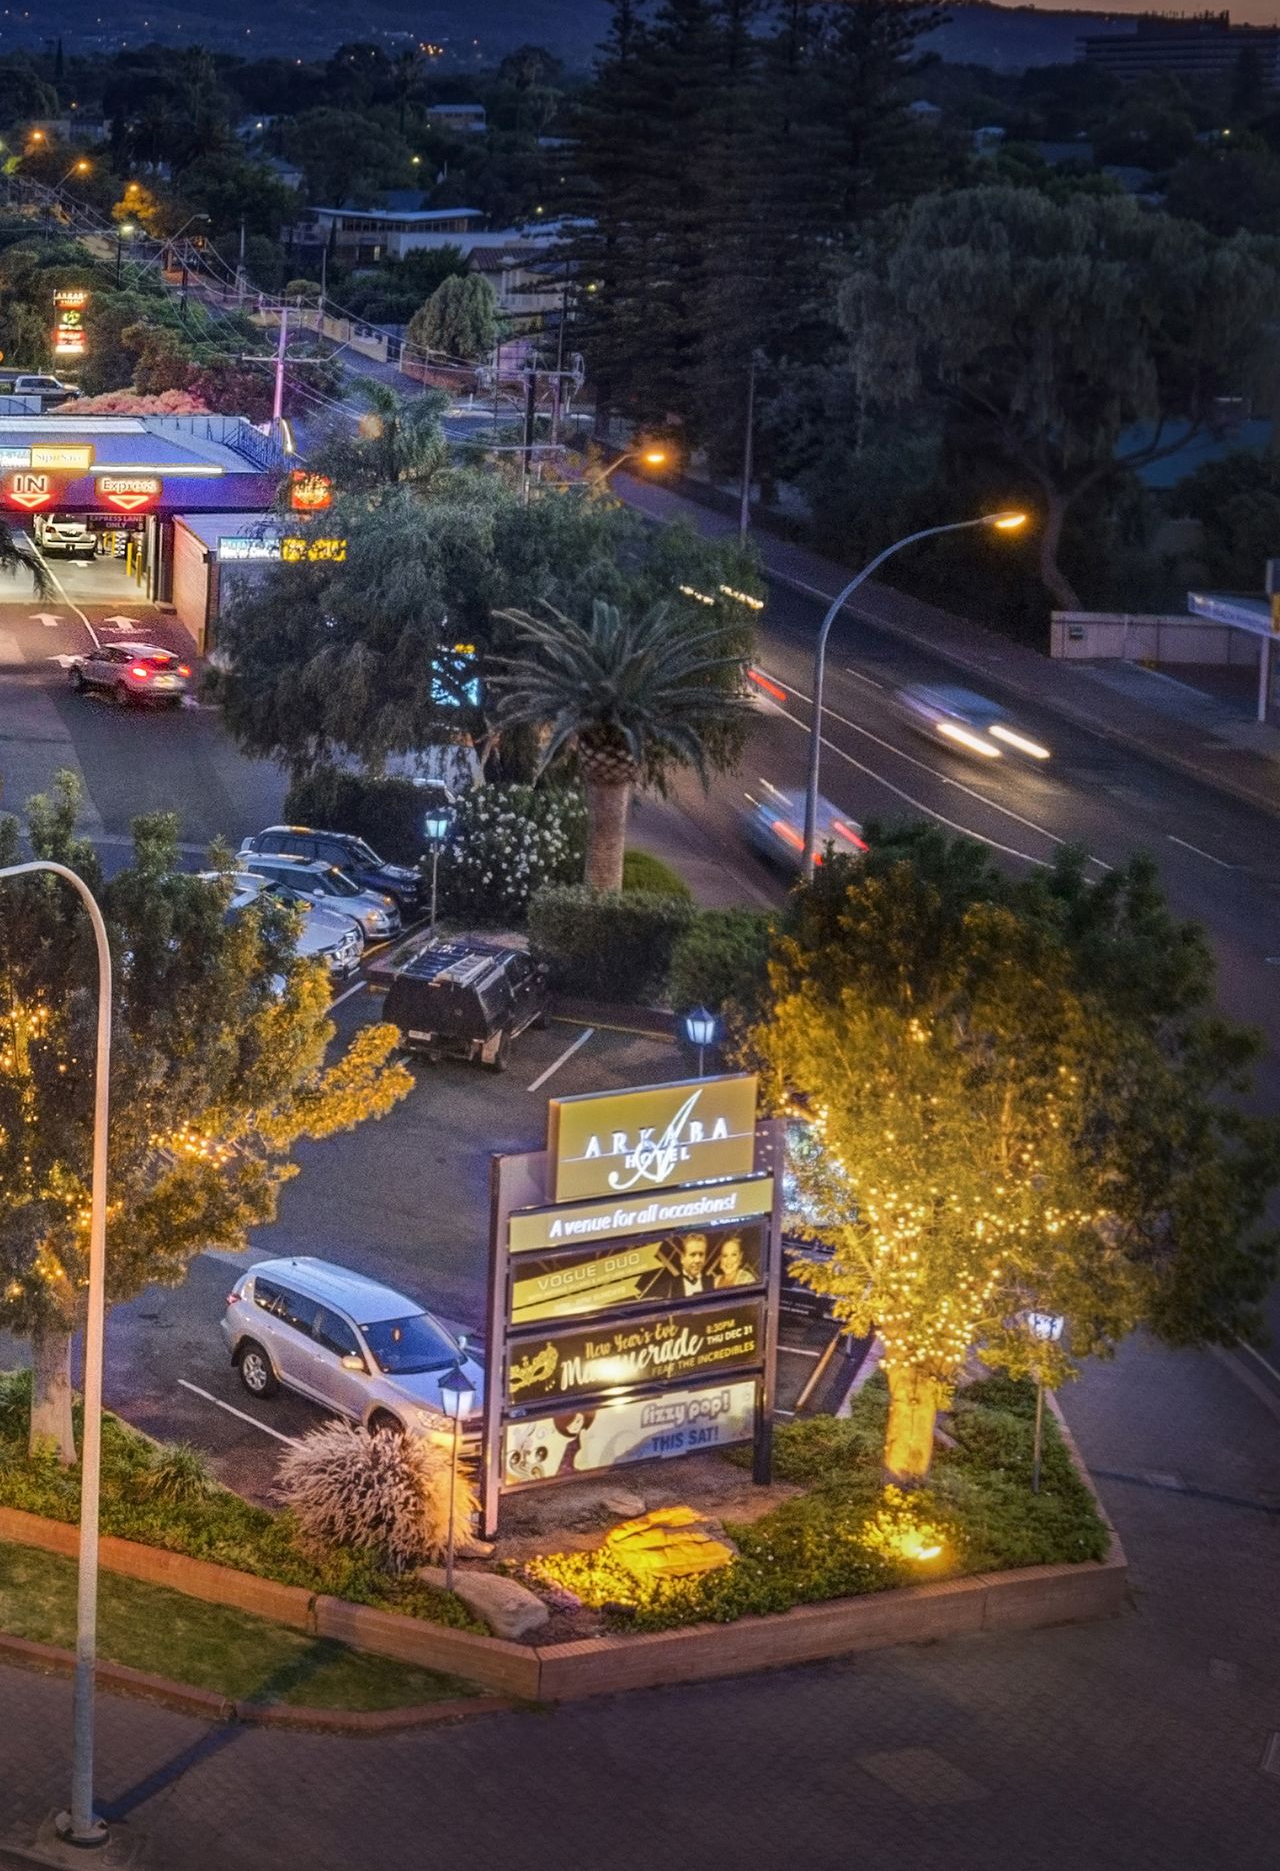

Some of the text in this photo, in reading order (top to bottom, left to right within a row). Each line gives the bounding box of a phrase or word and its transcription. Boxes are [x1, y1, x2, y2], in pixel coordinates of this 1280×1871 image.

[14, 475, 47, 493] IN
[102, 479, 157, 494] Express
[584, 1118, 729, 1159] ARKABA
[550, 1193, 738, 1238] A venue for all occasions!
[537, 1265, 597, 1290] VOGUE
[604, 1253, 640, 1272] DUO
[585, 1322, 679, 1359] New Year's Eve
[707, 1326, 753, 1345] THU DEC 31
[560, 1327, 705, 1391] Mauerade
[678, 1359, 695, 1370] THE
[698, 1340, 756, 1365] INCREDIBLES
[641, 1390, 731, 1428] fizzy pop!
[652, 1426, 719, 1452] THIS SAT!
